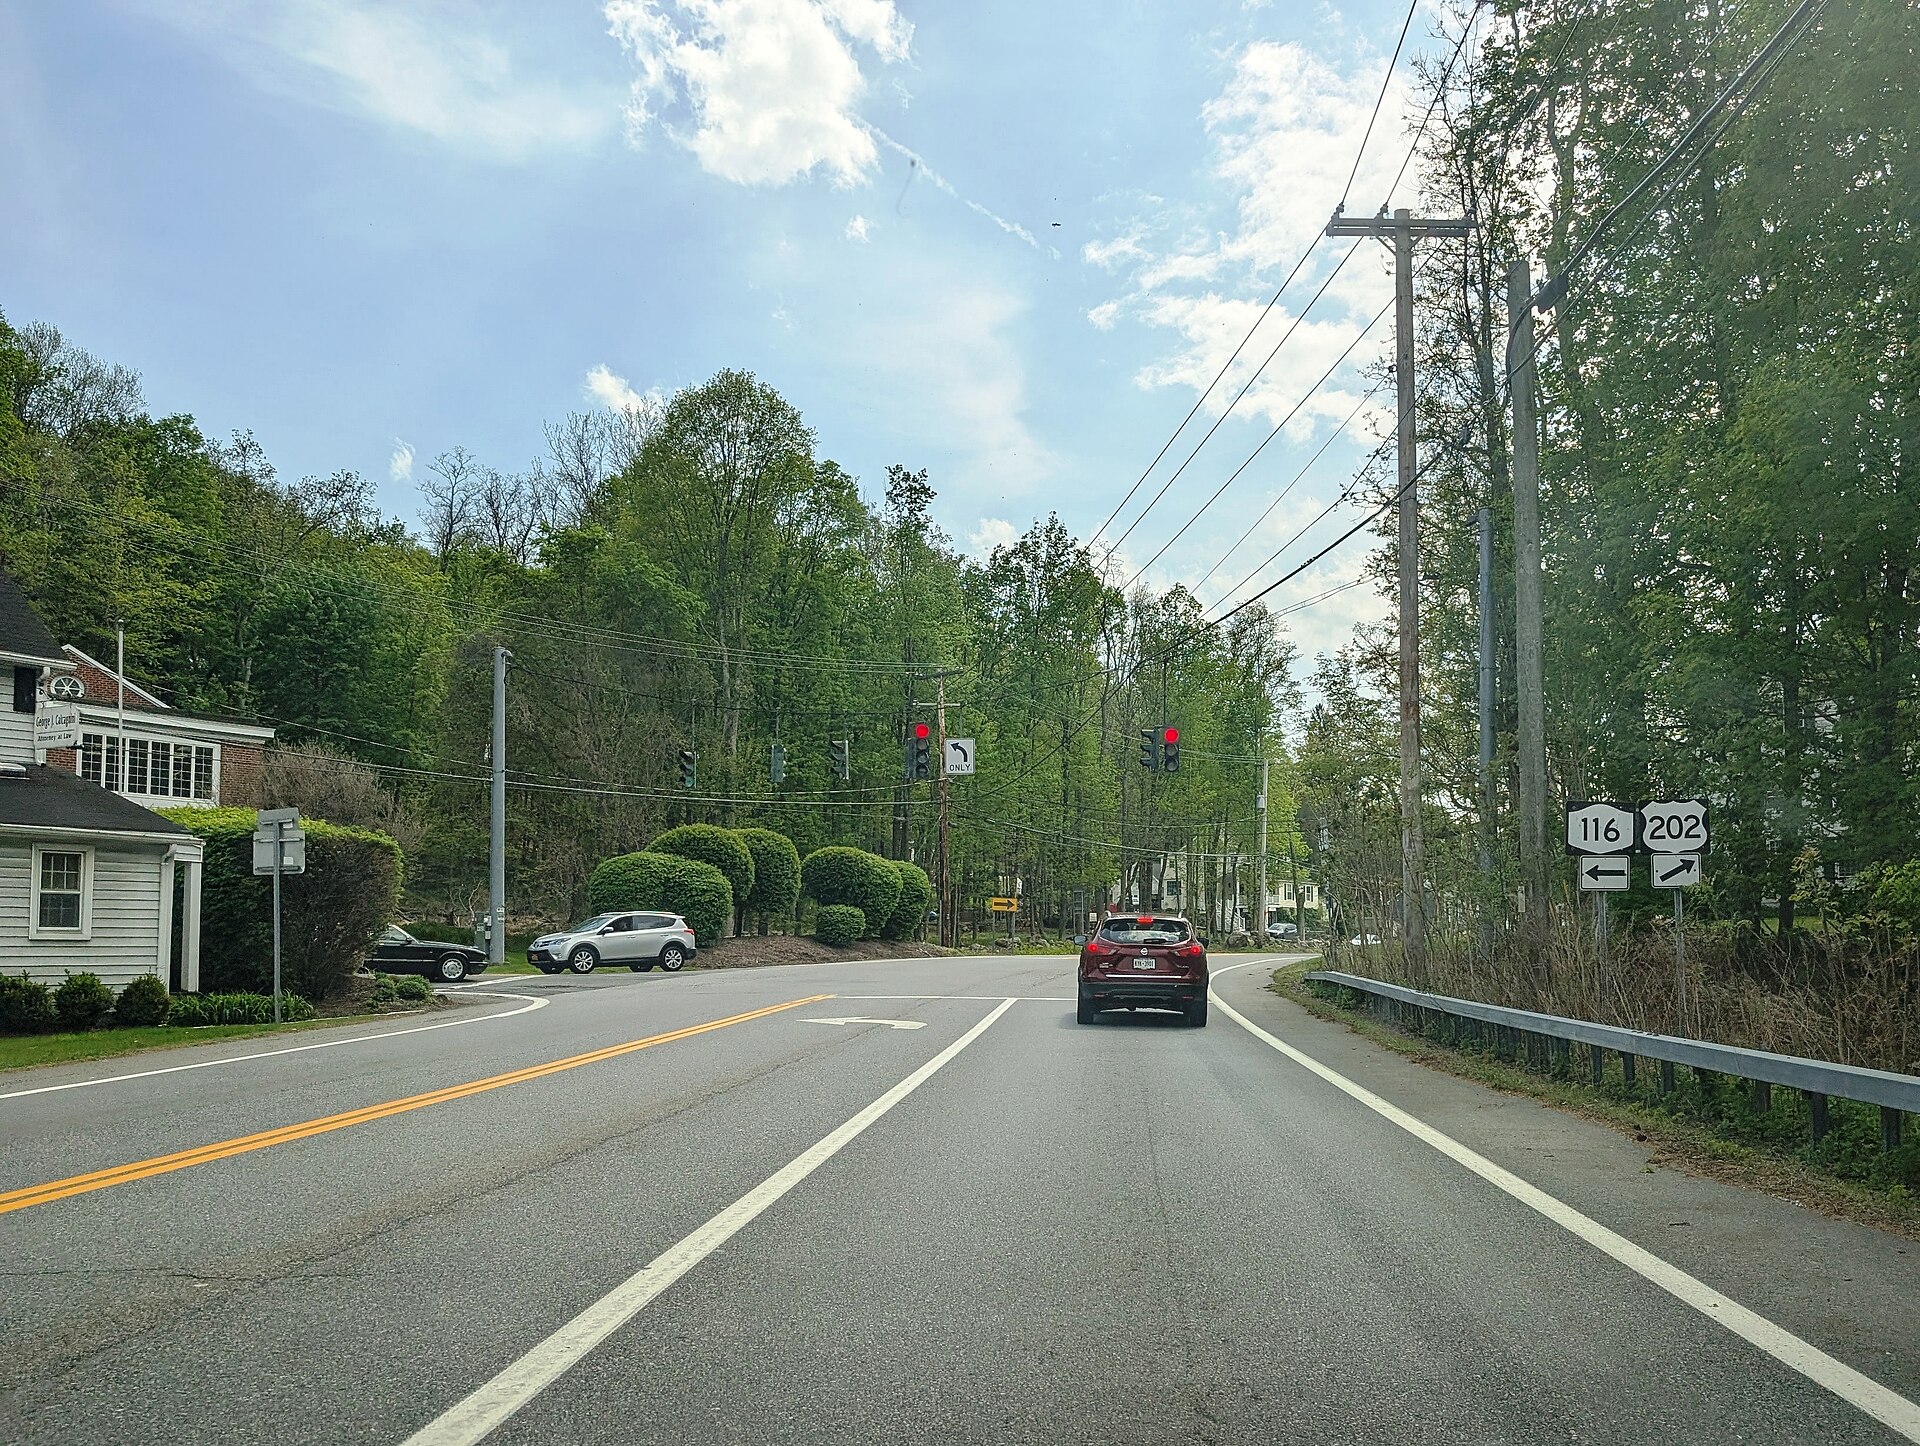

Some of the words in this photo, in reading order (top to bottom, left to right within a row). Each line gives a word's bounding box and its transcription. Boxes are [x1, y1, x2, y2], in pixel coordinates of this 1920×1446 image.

[36, 717, 50, 729] George
[949, 763, 970, 772] ONLY
[1581, 817, 1620, 842] 116
[1649, 814, 1701, 840] 202
